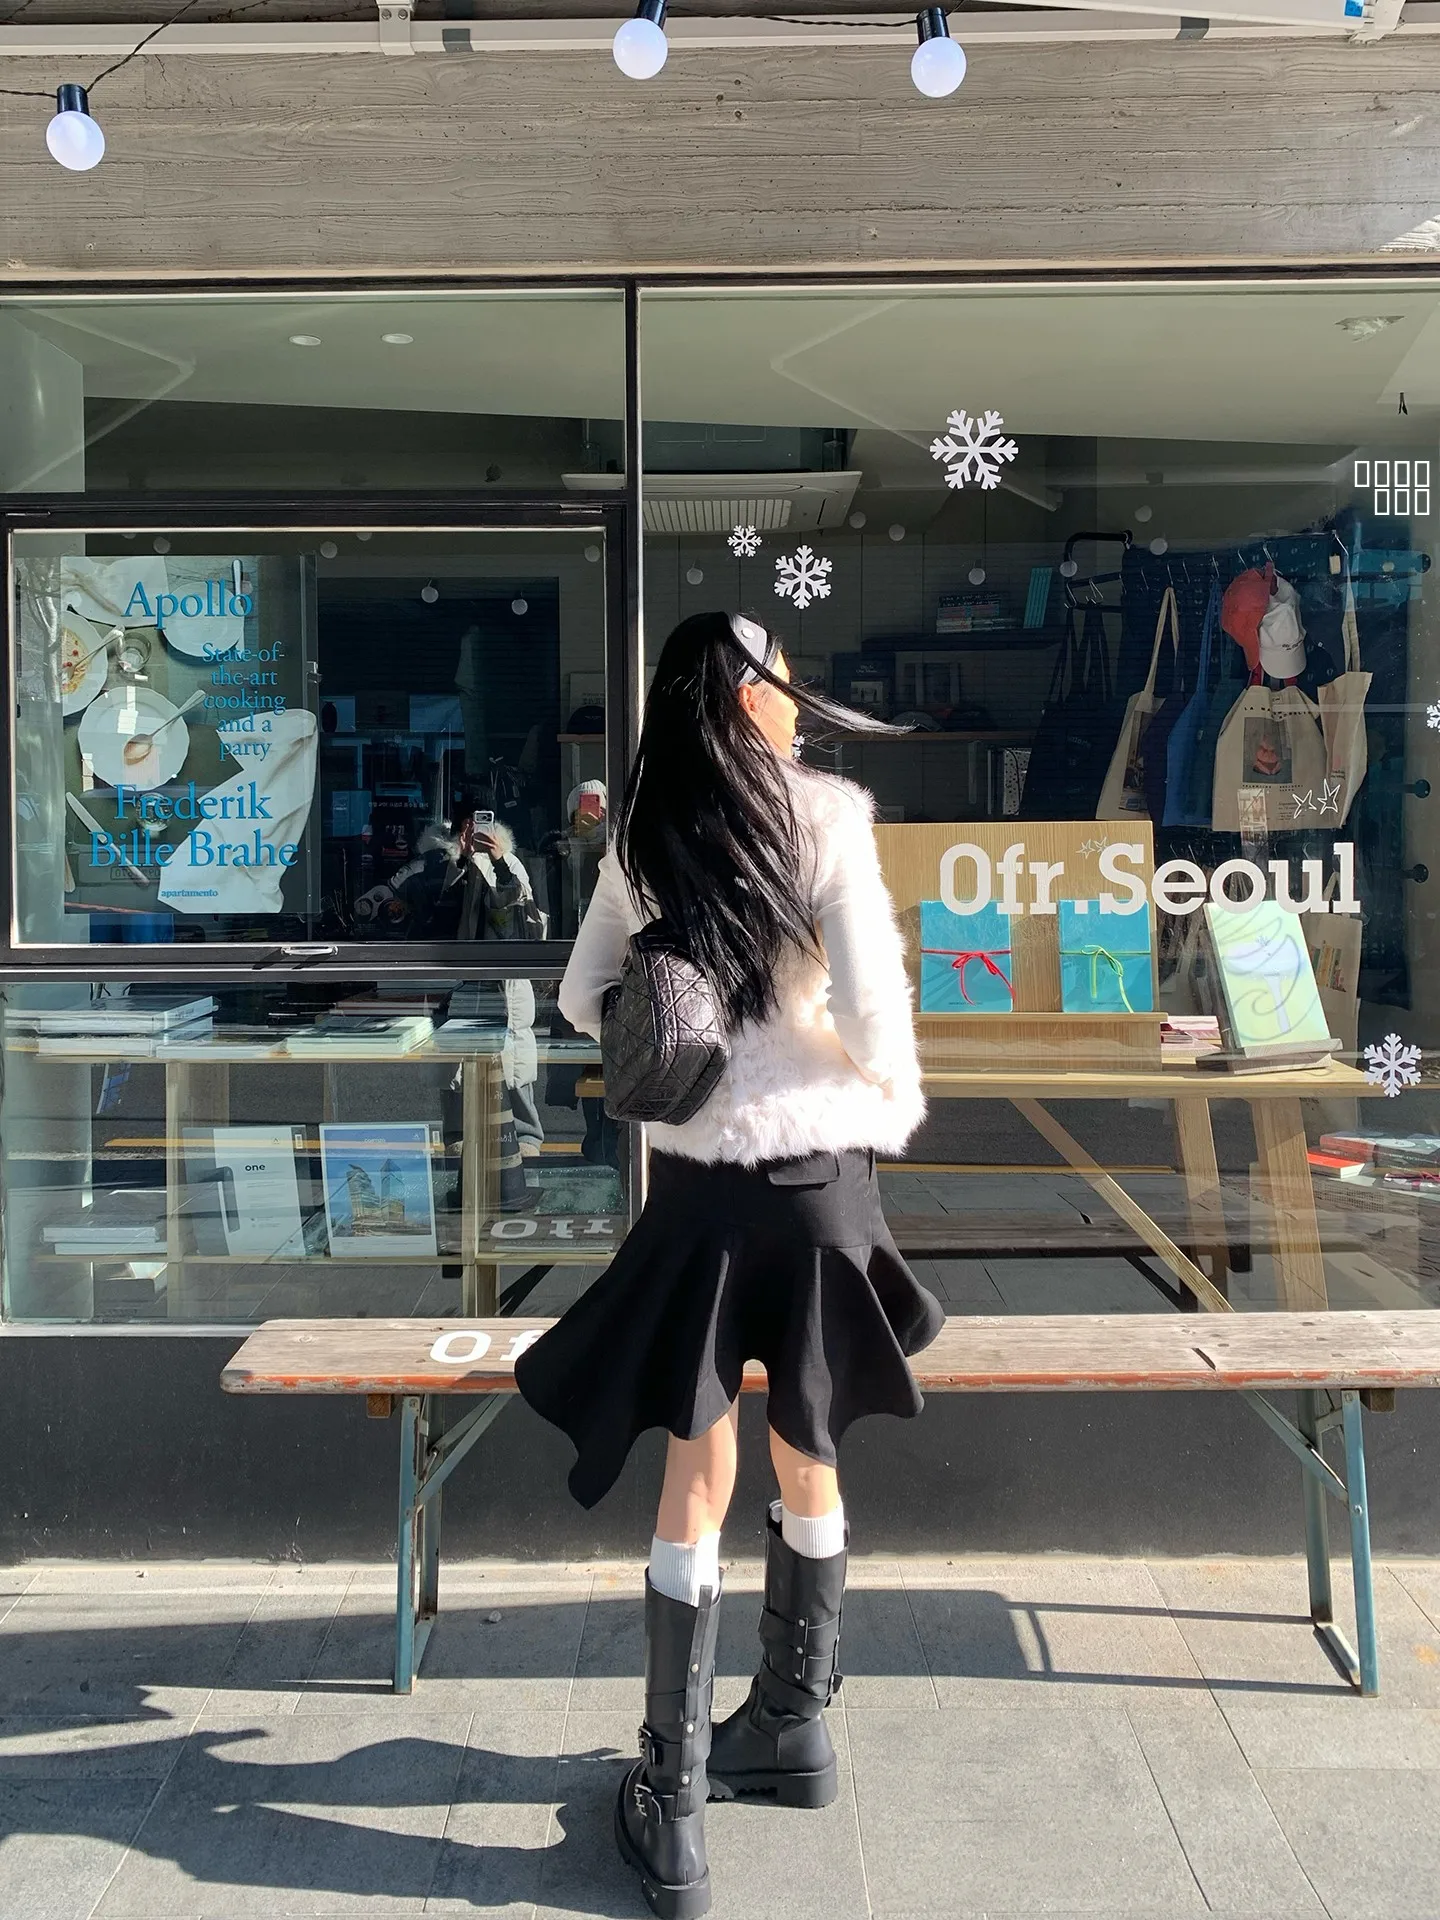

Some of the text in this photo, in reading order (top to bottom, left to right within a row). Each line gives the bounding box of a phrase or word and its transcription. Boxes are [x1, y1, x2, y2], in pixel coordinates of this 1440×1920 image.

[121, 580, 253, 630] Apollo
[202, 642, 285, 663] State-of-
[211, 670, 278, 685] the-art
[204, 689, 286, 713] cooking
[217, 713, 273, 732] and a
[219, 738, 273, 762] party
[113, 782, 273, 820] Frederik
[89, 829, 299, 867] Bille Brahe
[161, 889, 218, 898] apartamento
[244, 1163, 266, 1172] one
